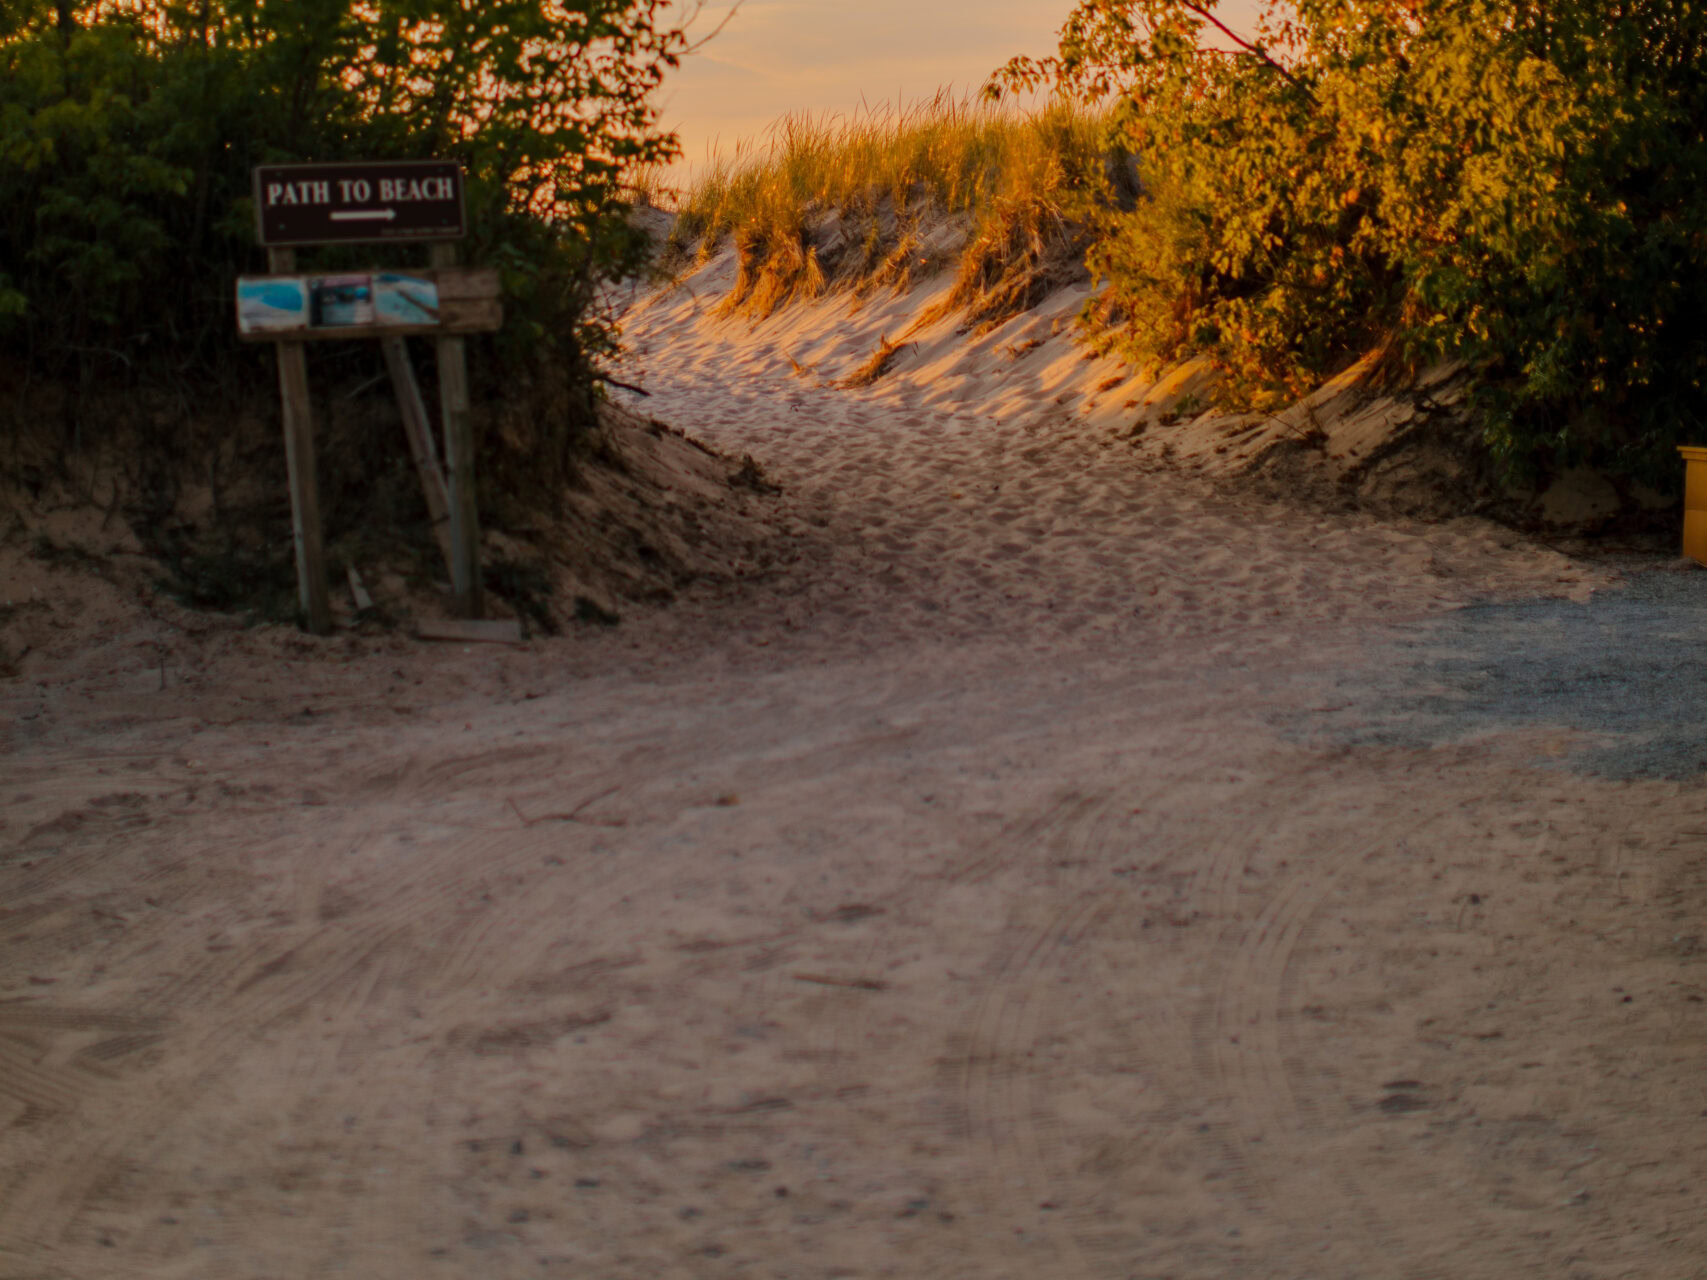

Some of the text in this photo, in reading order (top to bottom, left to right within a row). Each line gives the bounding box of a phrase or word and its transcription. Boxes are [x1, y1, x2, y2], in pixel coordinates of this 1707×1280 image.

[267, 177, 454, 206] PATH TO BEACH
